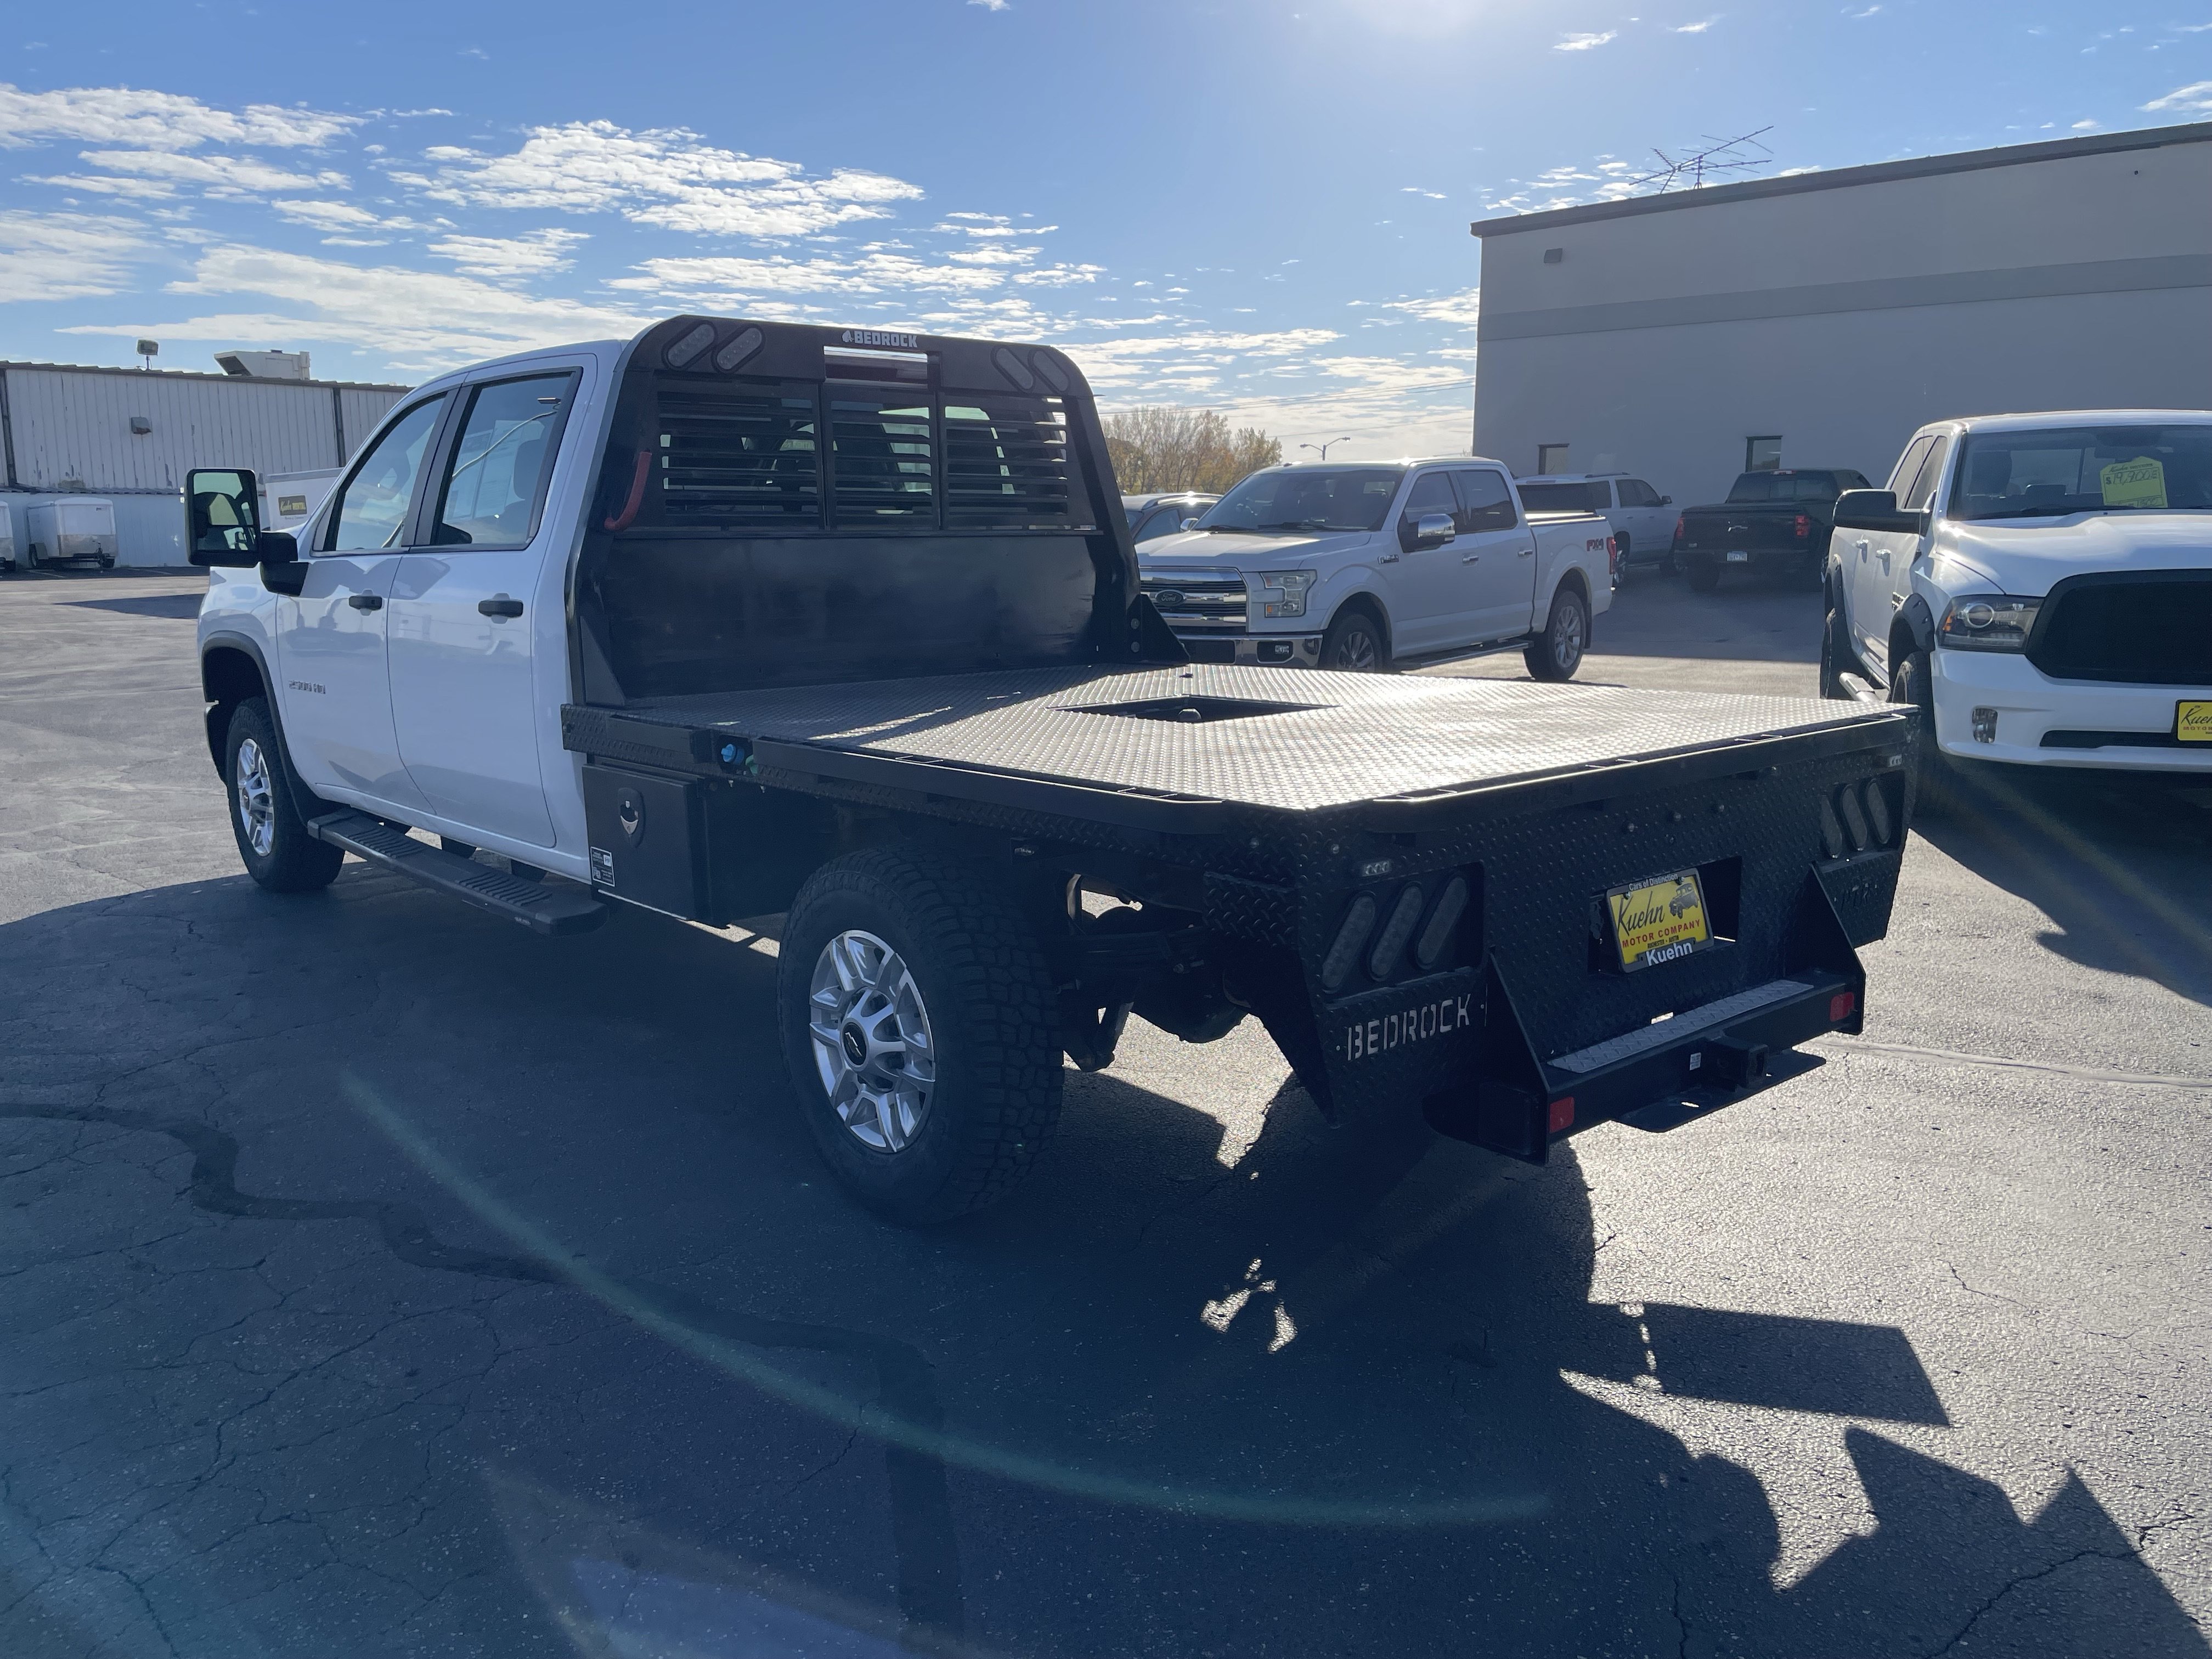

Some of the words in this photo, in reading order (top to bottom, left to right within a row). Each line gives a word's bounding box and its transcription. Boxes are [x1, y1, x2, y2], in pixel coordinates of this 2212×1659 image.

[854, 330, 918, 348] BEDROCK
[1629, 883, 1643, 891] Cars
[1643, 879, 1649, 888] of
[1649, 873, 1678, 886] Distinction
[1618, 890, 1666, 936] Kuehn
[1622, 933, 1655, 948] MOTOR
[1658, 919, 1701, 938] COMPANY
[1646, 942, 1692, 966] Kuehn
[1347, 994, 1471, 1061] BEDROCK
